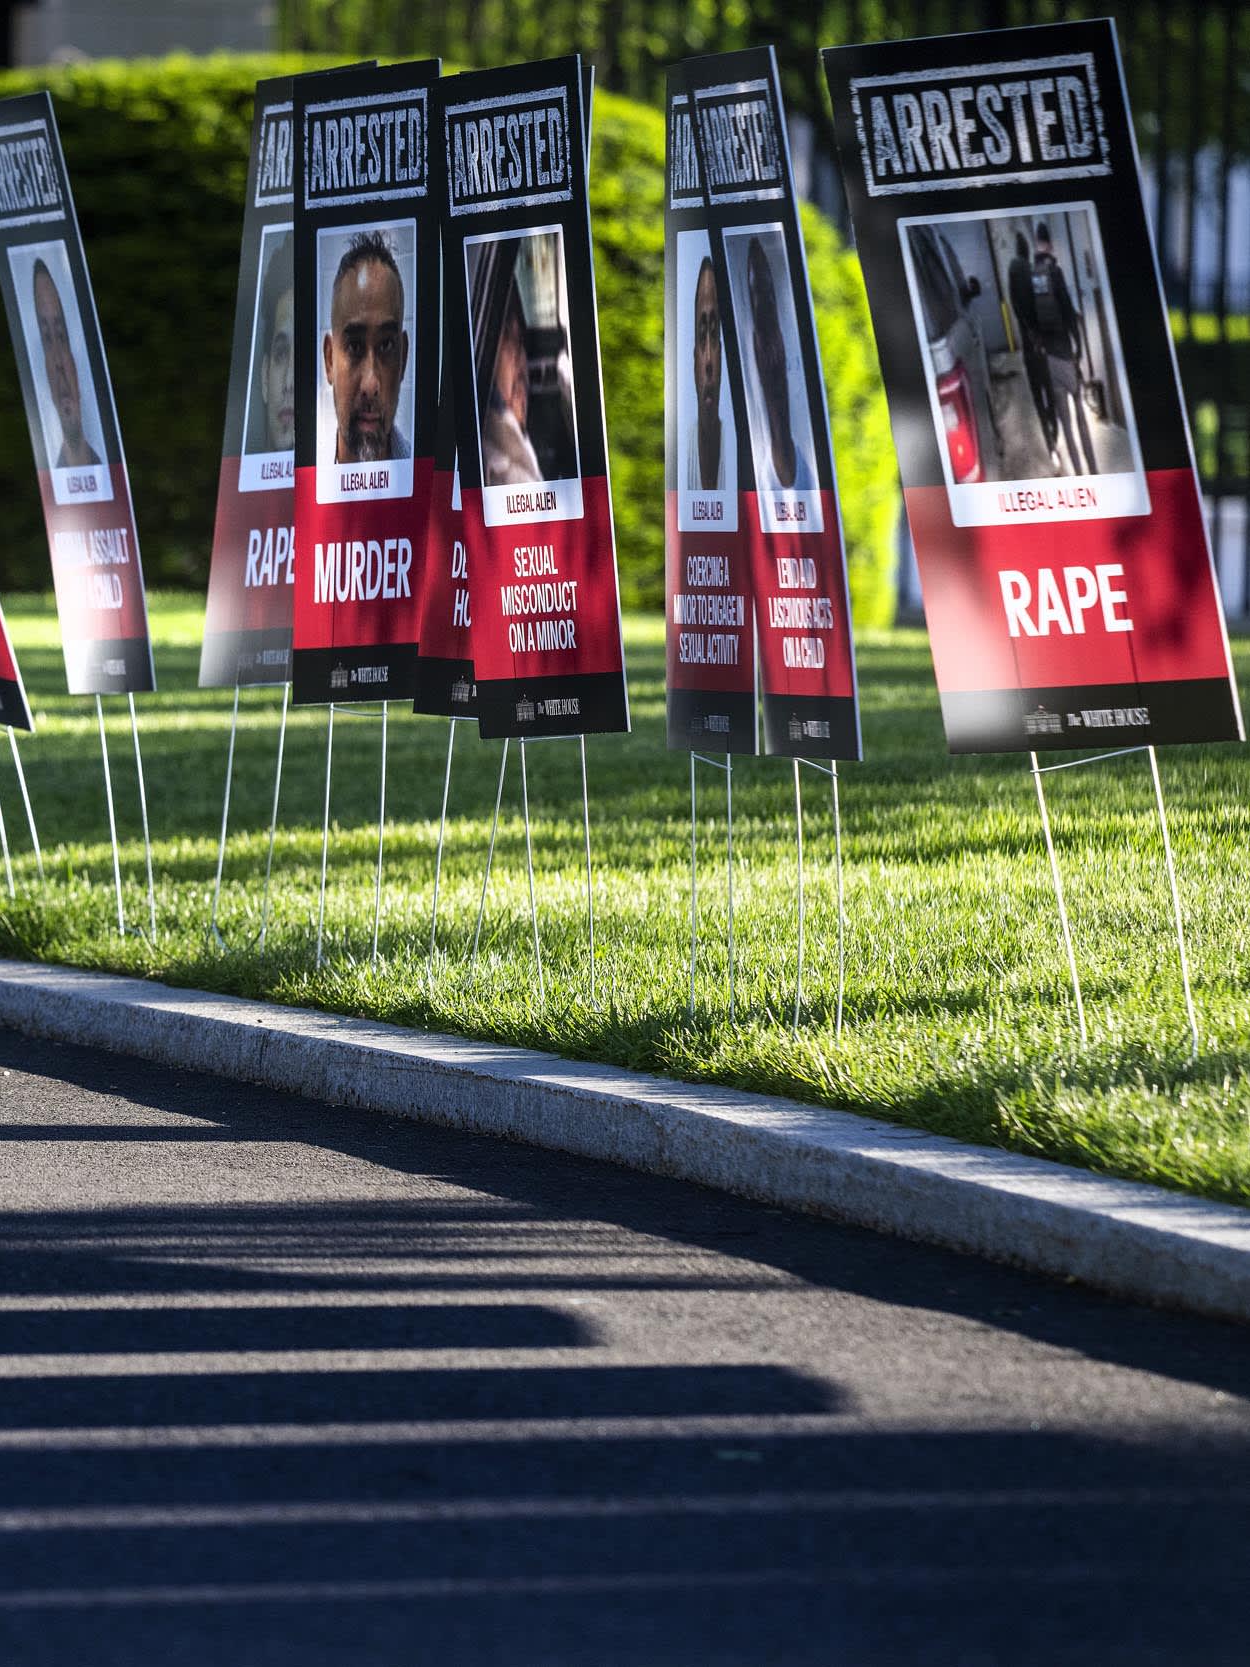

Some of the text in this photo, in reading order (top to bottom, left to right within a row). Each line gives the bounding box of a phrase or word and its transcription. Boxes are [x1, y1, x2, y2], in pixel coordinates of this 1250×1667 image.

[870, 75, 1095, 177] ARRESTED
[310, 108, 422, 192] ARRESTED
[454, 107, 565, 198] ARRESTED
[703, 100, 777, 186] ARRESTED
[340, 470, 390, 492] ILLEGAL ALIEN
[506, 491, 557, 514] ILLEGAL ALIEN
[1000, 487, 1098, 513] ILLEGAL ALIEN
[313, 538, 413, 604] MURDER
[514, 545, 559, 578] SEXUAL
[687, 556, 730, 587] COERCING A
[501, 581, 578, 617] MISCONDUCT
[673, 595, 697, 625] MINOR
[697, 595, 707, 625] TO
[707, 595, 737, 626] ENGAGE
[998, 563, 1135, 638] RAPE
[508, 619, 578, 653] ON A MINOR
[679, 632, 739, 665] SEXUAL ACTIVITY
[544, 699, 562, 716] WHITE
[561, 698, 581, 715] HOUSE
